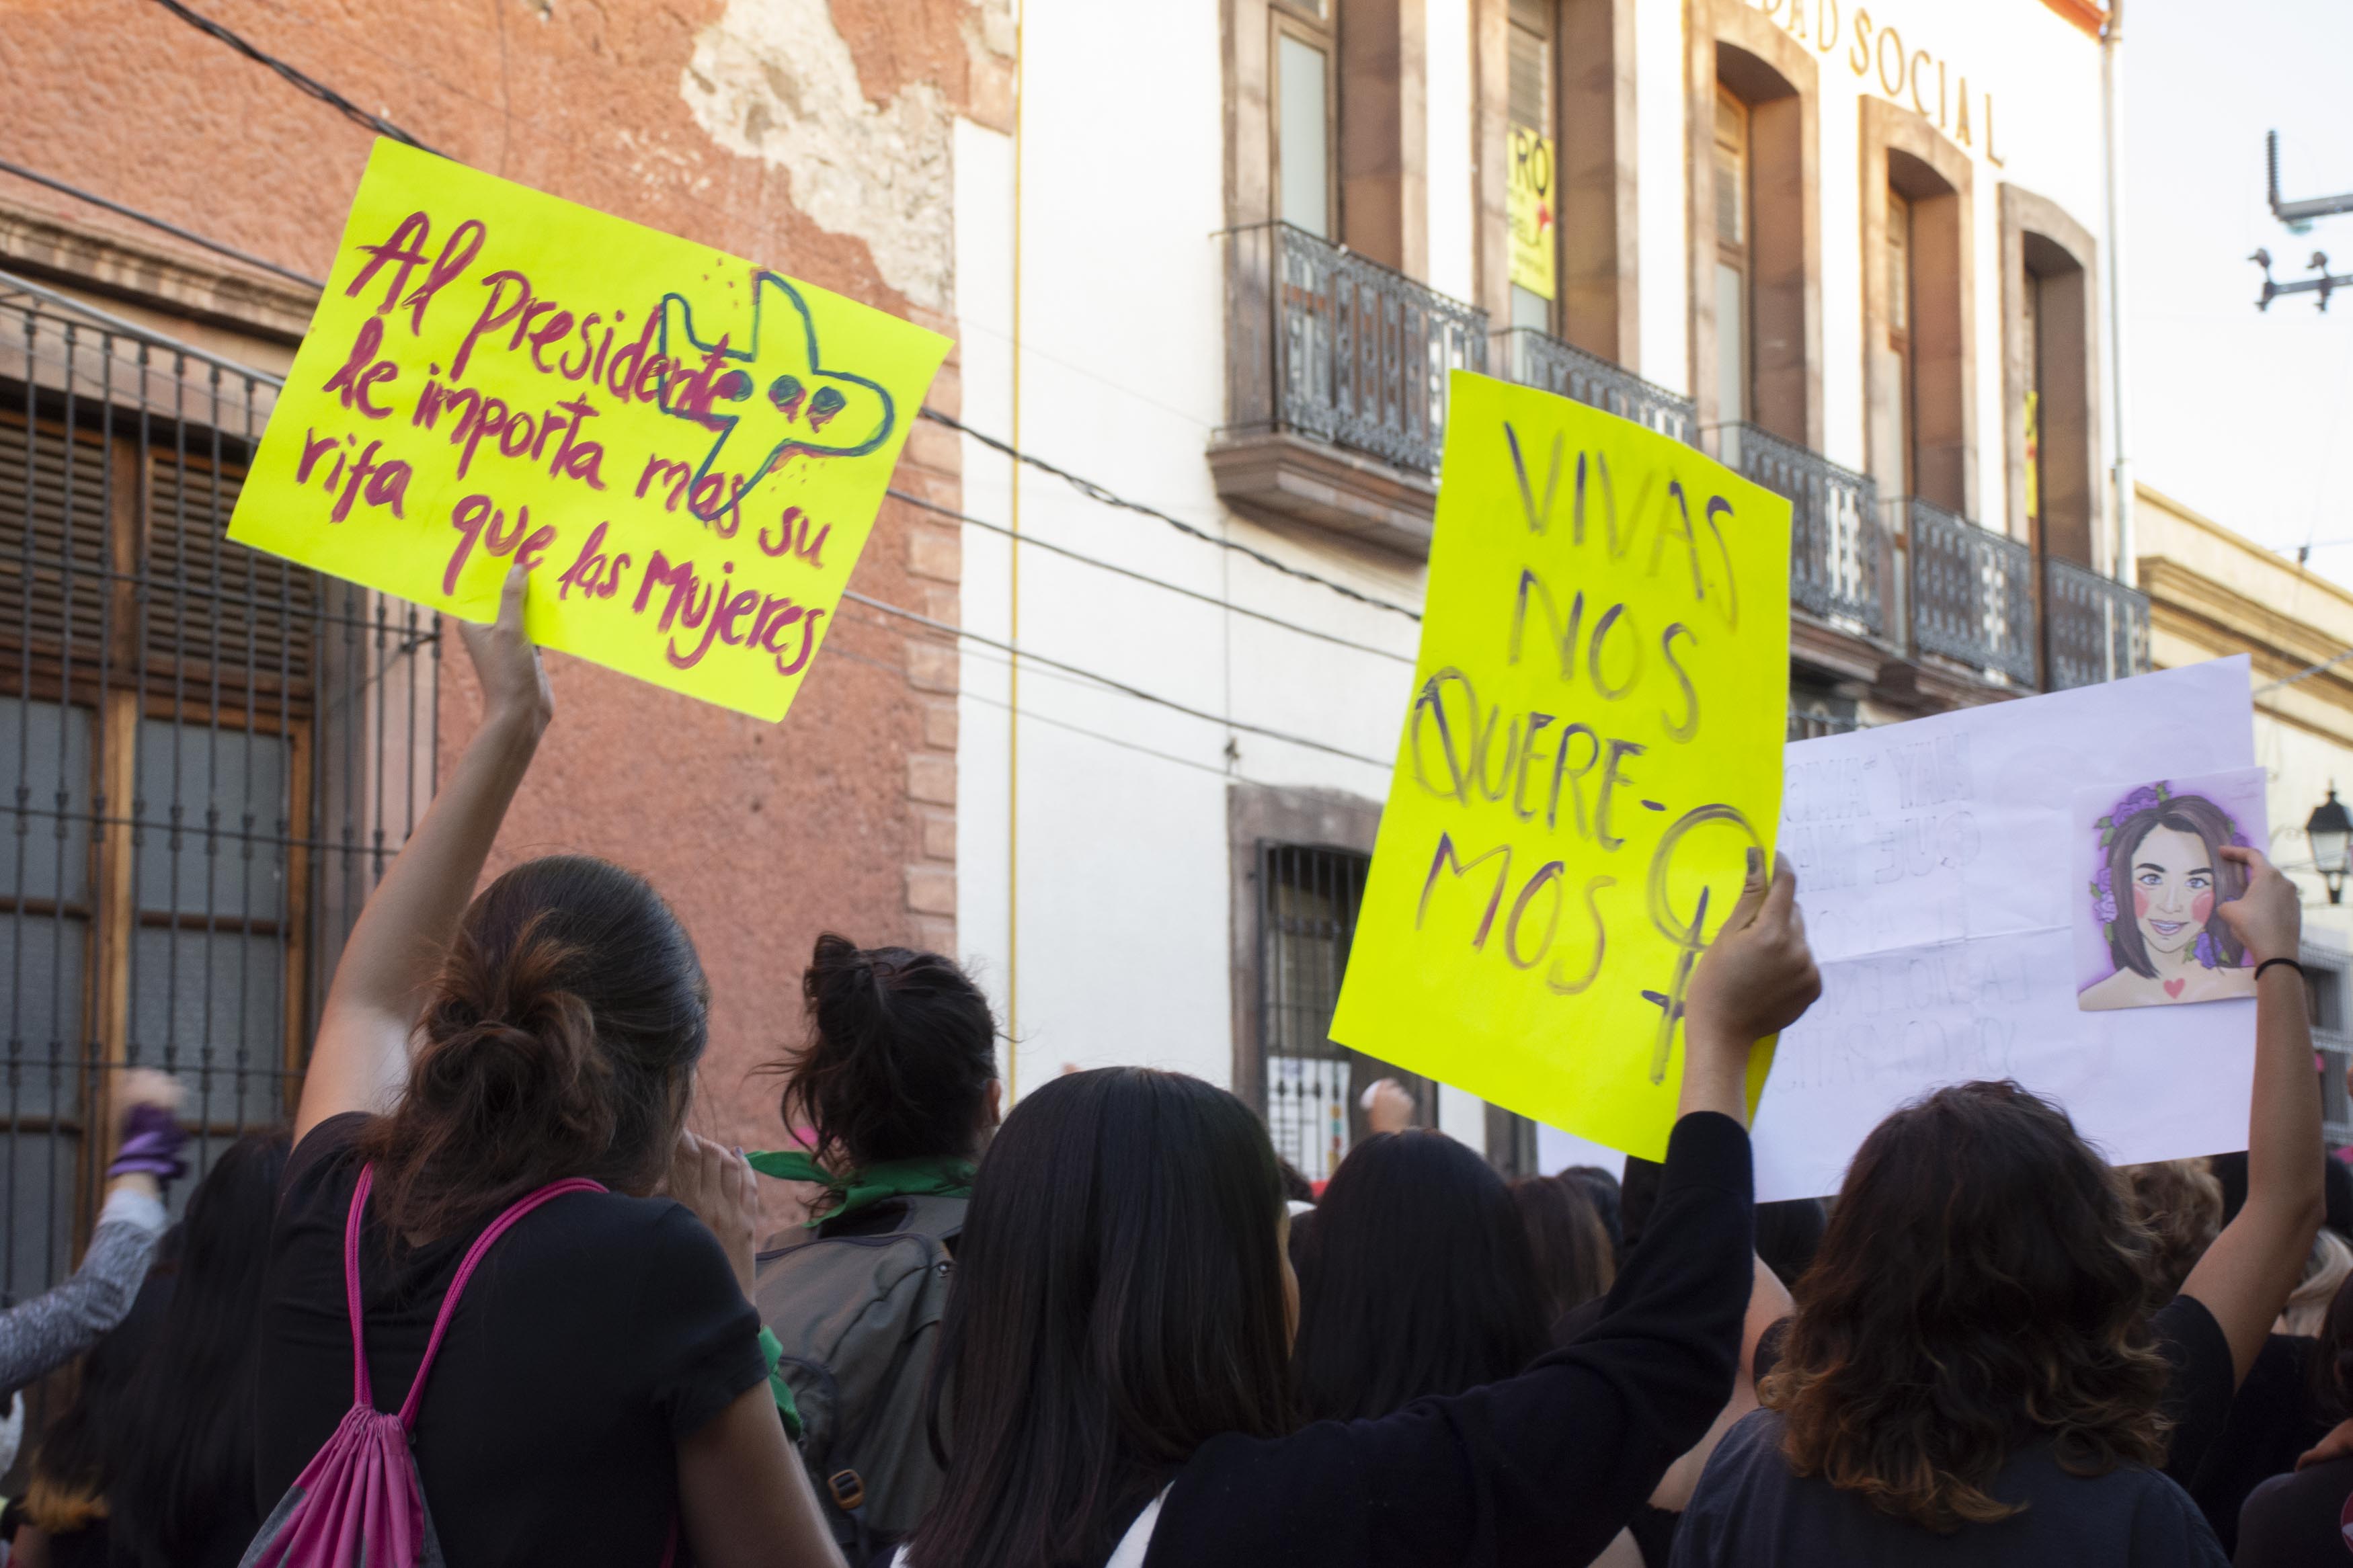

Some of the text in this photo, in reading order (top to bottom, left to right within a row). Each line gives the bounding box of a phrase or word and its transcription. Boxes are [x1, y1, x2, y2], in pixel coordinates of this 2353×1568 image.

[1849, 8, 2004, 168] SOCIAL
[346, 210, 486, 335] Al
[296, 427, 411, 524] rifa
[442, 494, 557, 595] que
[557, 520, 631, 600] las
[324, 317, 397, 418] le
[412, 363, 606, 491] importa
[758, 505, 832, 567] su
[1503, 421, 1738, 633] VIVAS
[1509, 568, 1700, 743] NOS
[1412, 667, 1666, 852] QUERE-
[1417, 831, 1616, 995] MOS
